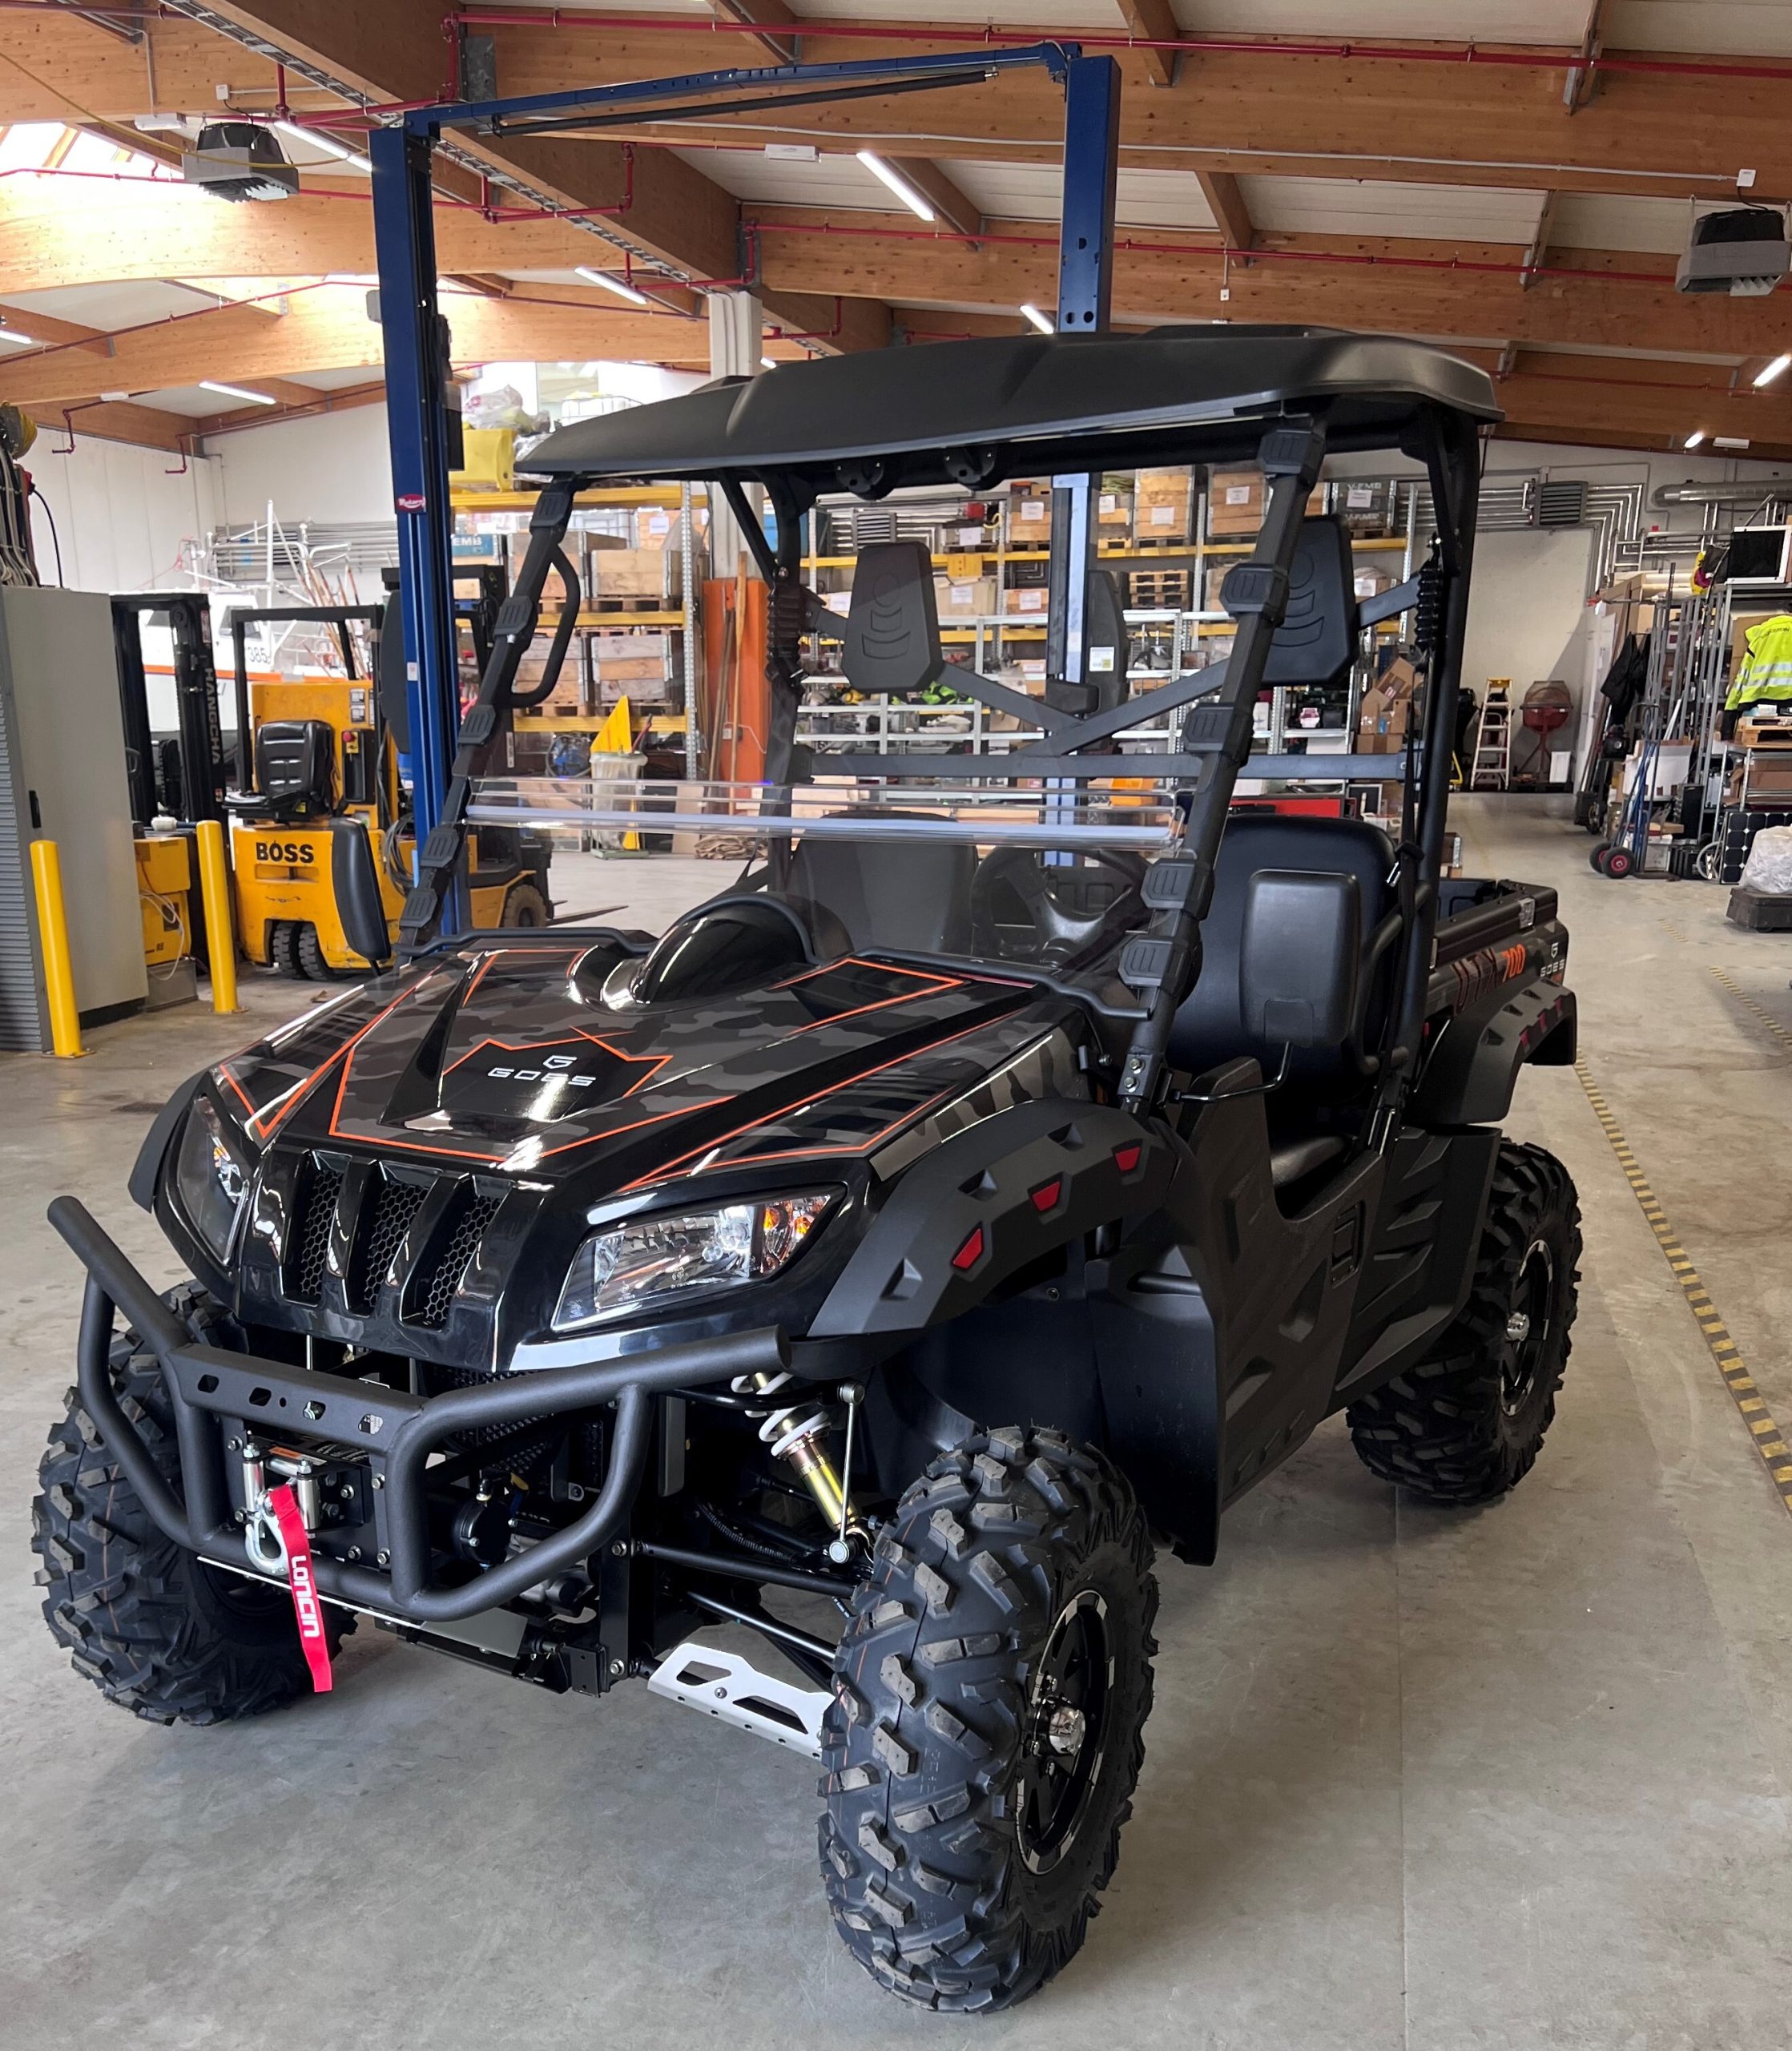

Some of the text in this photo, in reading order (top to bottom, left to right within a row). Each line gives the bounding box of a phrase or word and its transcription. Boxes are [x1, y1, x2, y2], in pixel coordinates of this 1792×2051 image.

[204, 667, 221, 764] HANGCHA
[256, 841, 315, 864] BOSS
[1540, 958, 1565, 978] GOES
[487, 1067, 597, 1087] GOES
